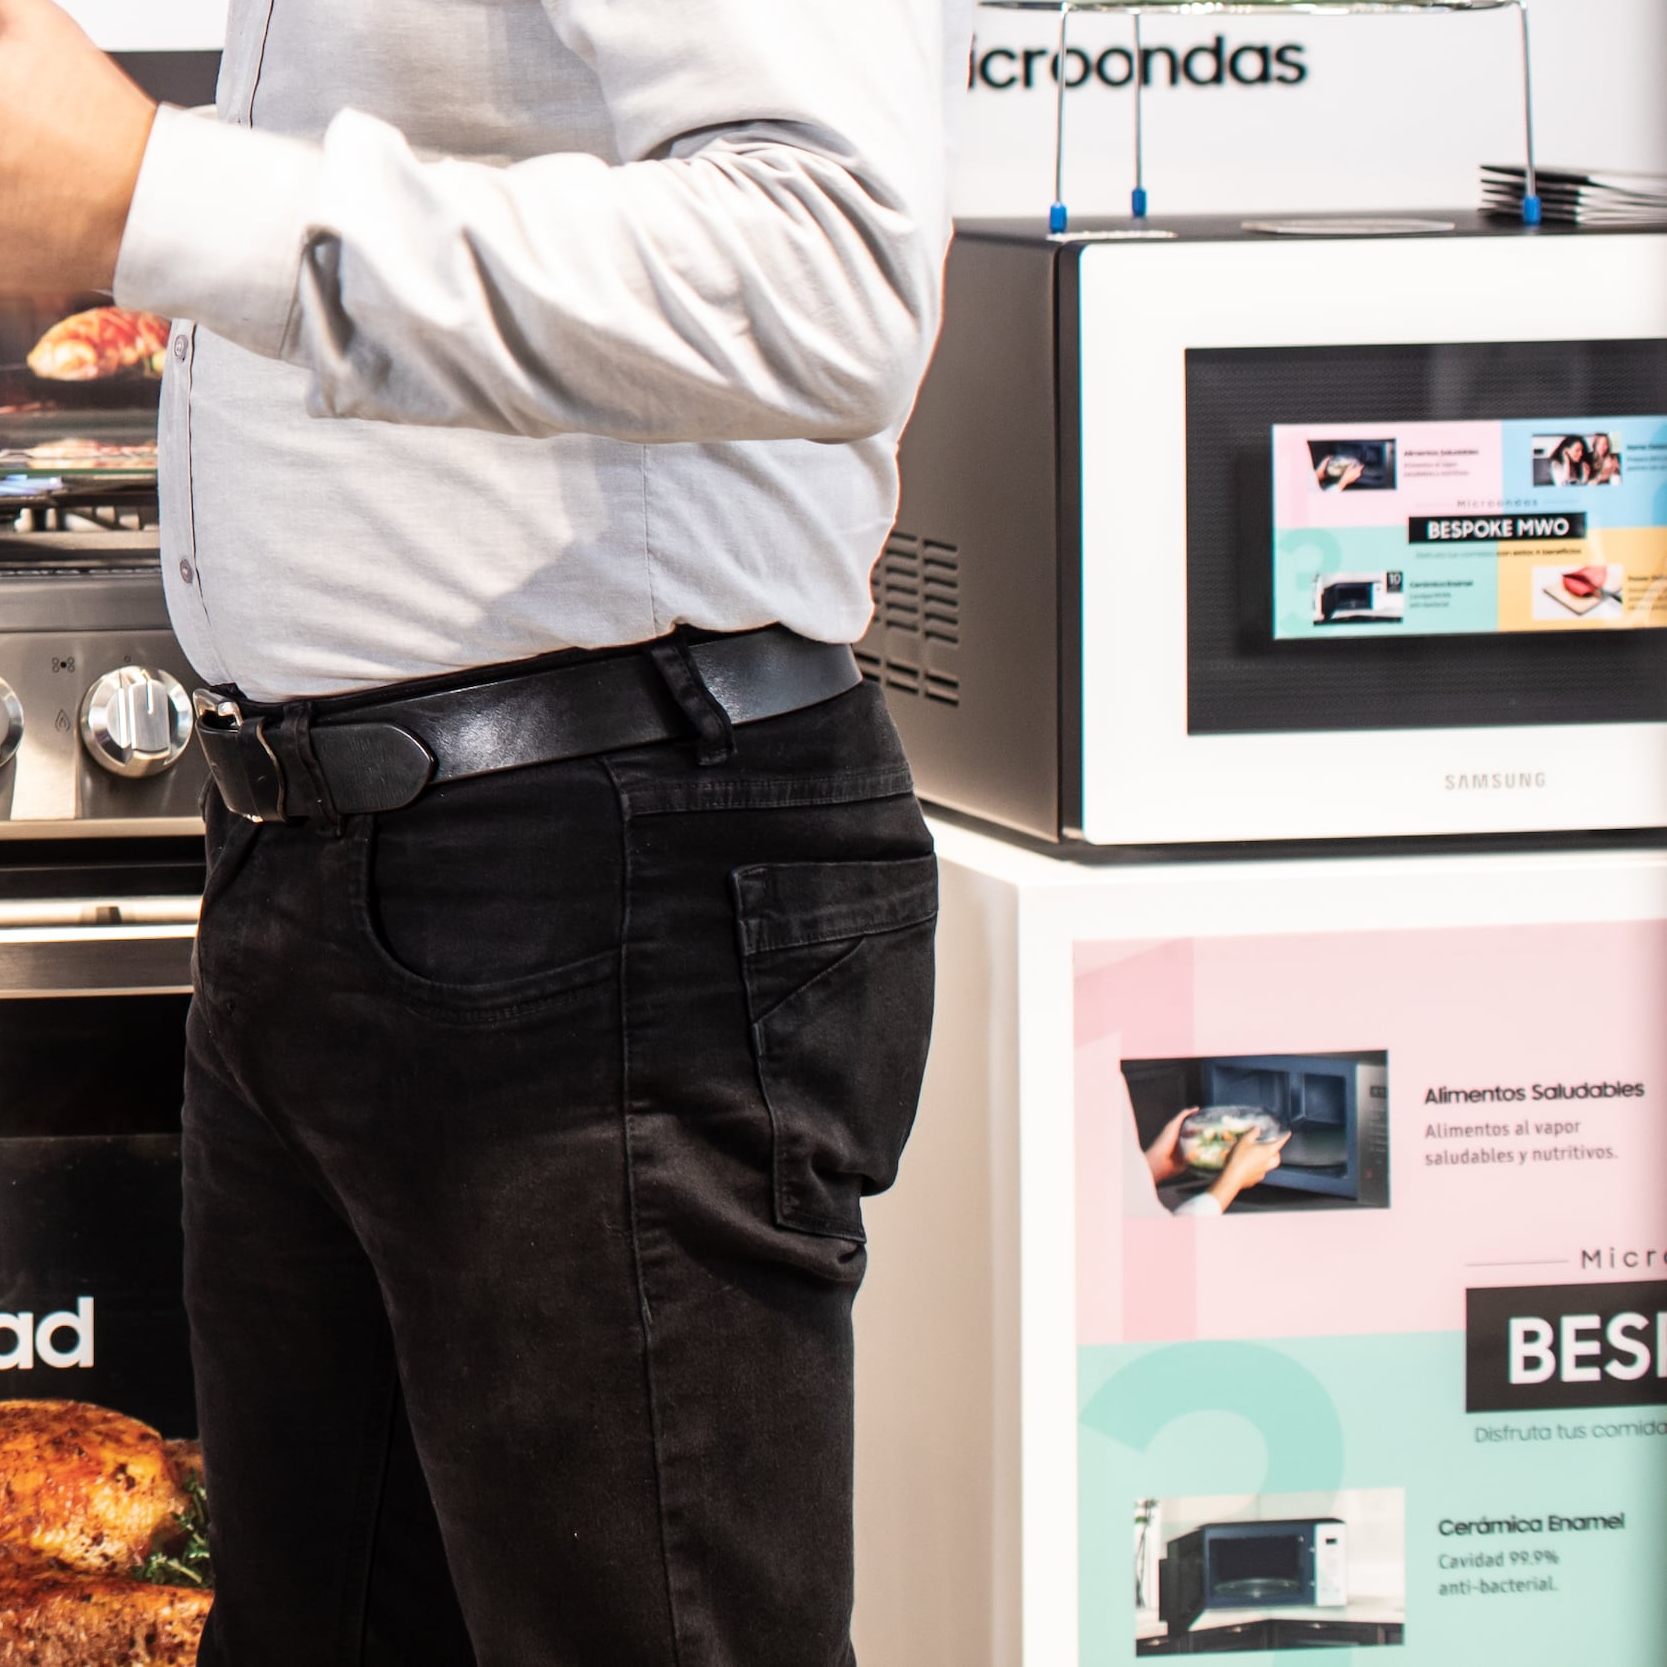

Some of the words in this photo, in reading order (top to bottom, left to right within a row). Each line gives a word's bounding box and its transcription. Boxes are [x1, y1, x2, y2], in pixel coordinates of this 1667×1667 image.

[968, 33, 1308, 89] icroondas
[1427, 519, 1513, 540] BESPOKE
[1518, 517, 1570, 538] MWO
[1445, 771, 1547, 791] SAMSUNG
[1425, 1084, 1526, 1105] Alimentos
[1532, 1081, 1645, 1101] Saludables
[1425, 1122, 1509, 1139] Alimentos
[1514, 1120, 1530, 1136] al
[1534, 1120, 1581, 1137] vapor
[1425, 1147, 1515, 1166] saludables
[1519, 1150, 1528, 1166] y
[1532, 1145, 1619, 1162] nutritivos.
[1508, 1310, 1667, 1385] BES
[1474, 1425, 1552, 1444] Disfruta
[1557, 1423, 1587, 1440] tus
[1438, 1515, 1543, 1536] Cerámica
[1548, 1512, 1626, 1532] Enamel
[1438, 1551, 1505, 1570] Cavidad
[1508, 1549, 1560, 1566] 99.9%
